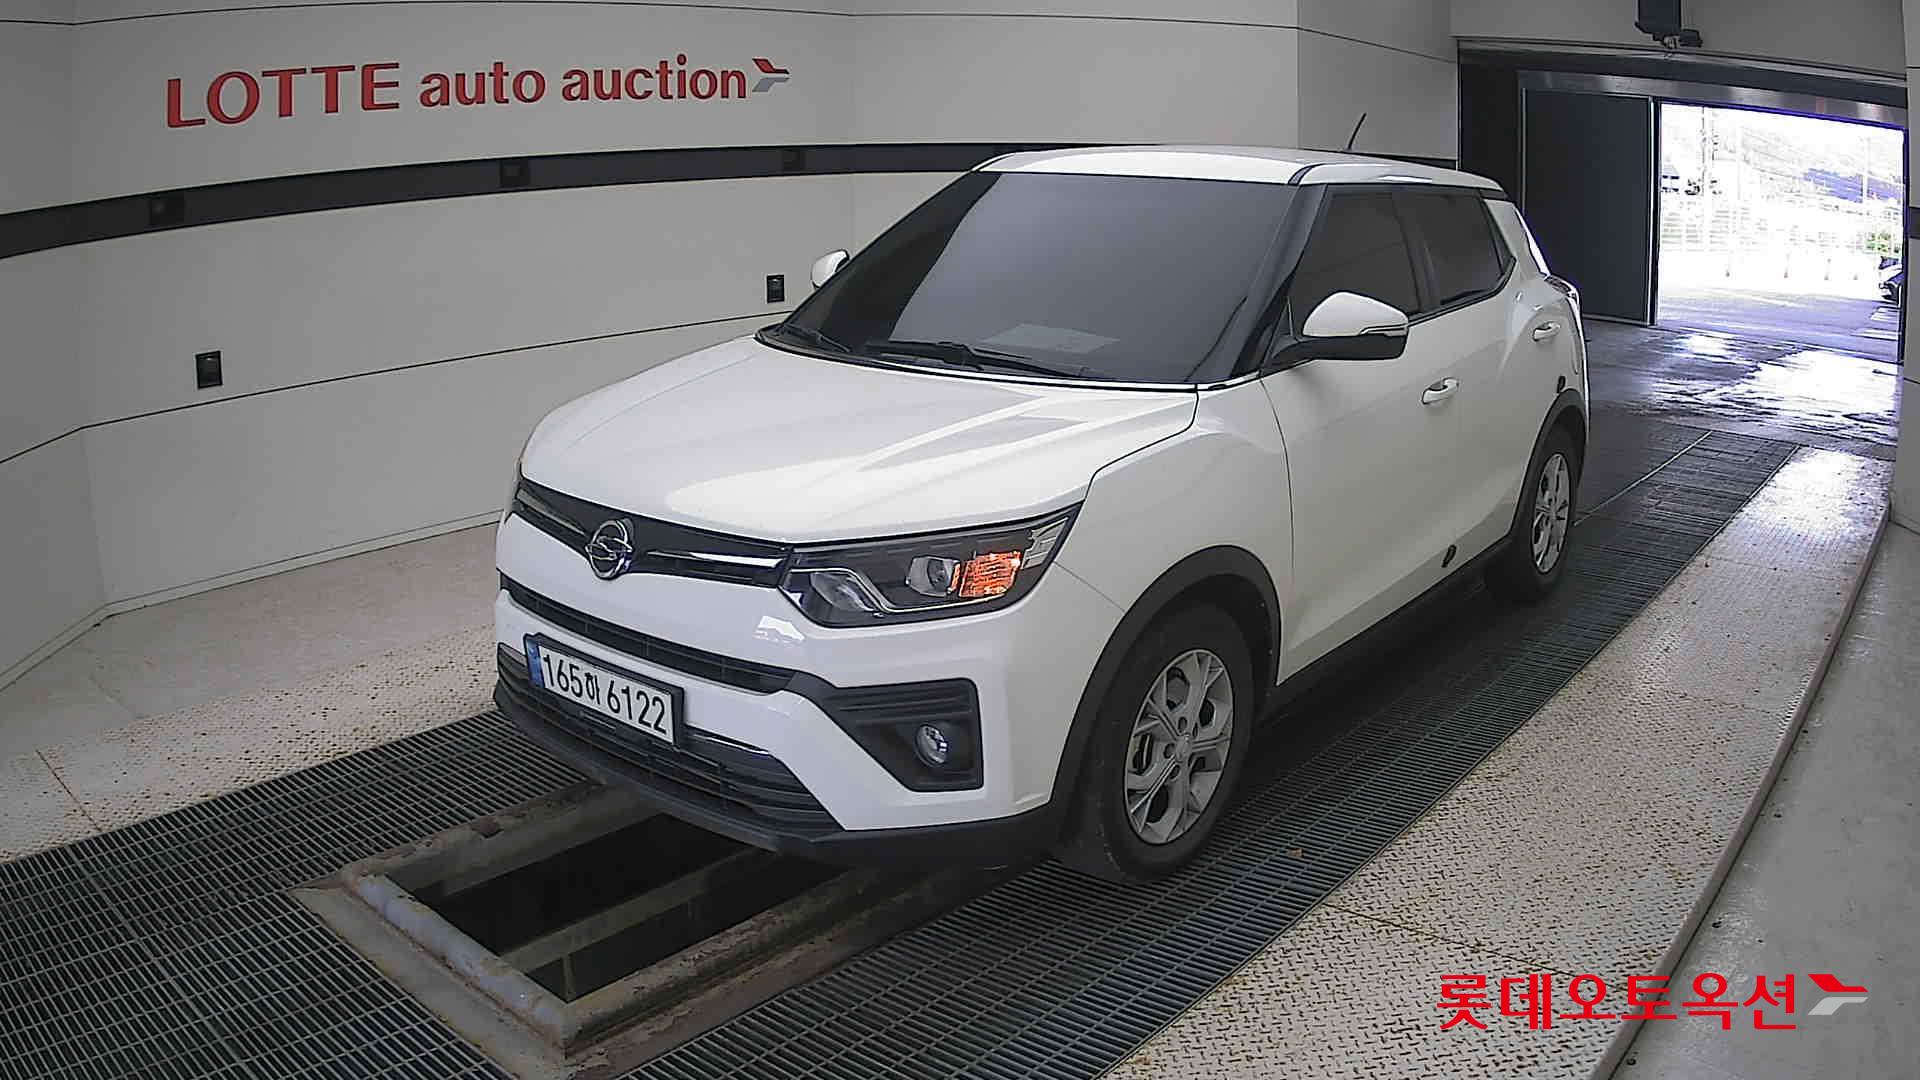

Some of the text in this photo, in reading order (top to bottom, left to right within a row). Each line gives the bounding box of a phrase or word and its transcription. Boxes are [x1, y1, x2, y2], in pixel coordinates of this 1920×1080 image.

[166, 54, 748, 128] LOTTE auto auction
[543, 654, 667, 734] 165하 6122
